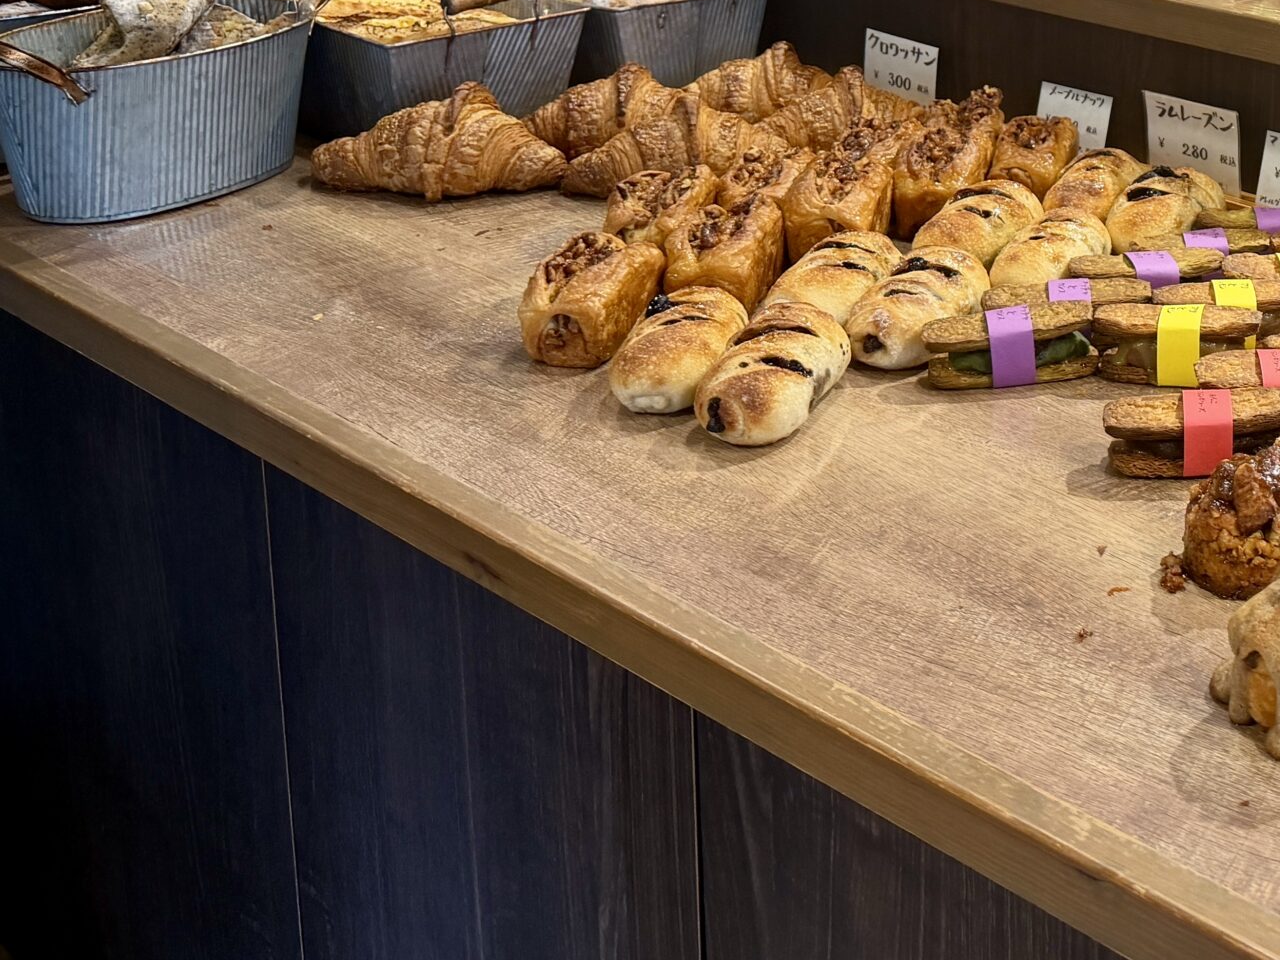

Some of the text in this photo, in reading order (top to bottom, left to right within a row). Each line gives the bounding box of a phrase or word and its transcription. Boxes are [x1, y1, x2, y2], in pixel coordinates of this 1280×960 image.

[868, 33, 936, 66] クロワッサン
[888, 72, 911, 91] 300
[1049, 86, 1105, 107] メープルナッツ
[1155, 100, 1233, 132] ラムレーズン
[1158, 136, 1165, 148] ¥
[1182, 143, 1208, 160] 280
